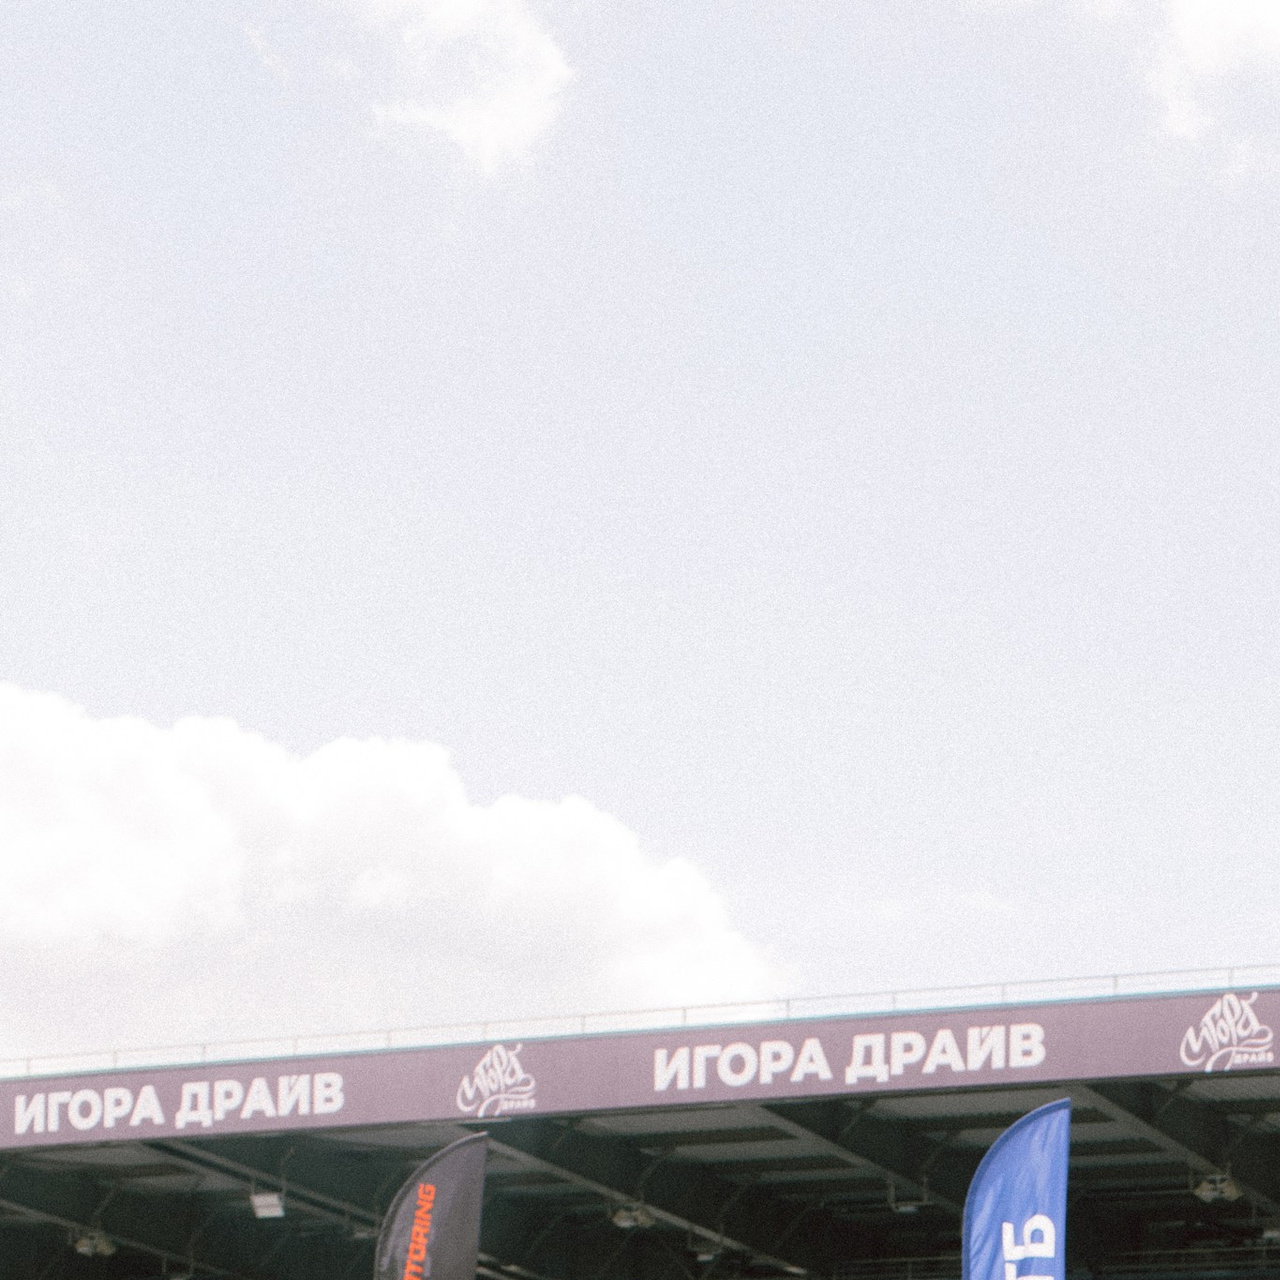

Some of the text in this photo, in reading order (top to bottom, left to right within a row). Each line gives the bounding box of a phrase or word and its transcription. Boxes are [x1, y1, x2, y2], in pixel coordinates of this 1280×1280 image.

[653, 1023, 1047, 1092] ИГОРА ДРАЙВ
[13, 1072, 345, 1135] ИГОРА ДРАЙВ
